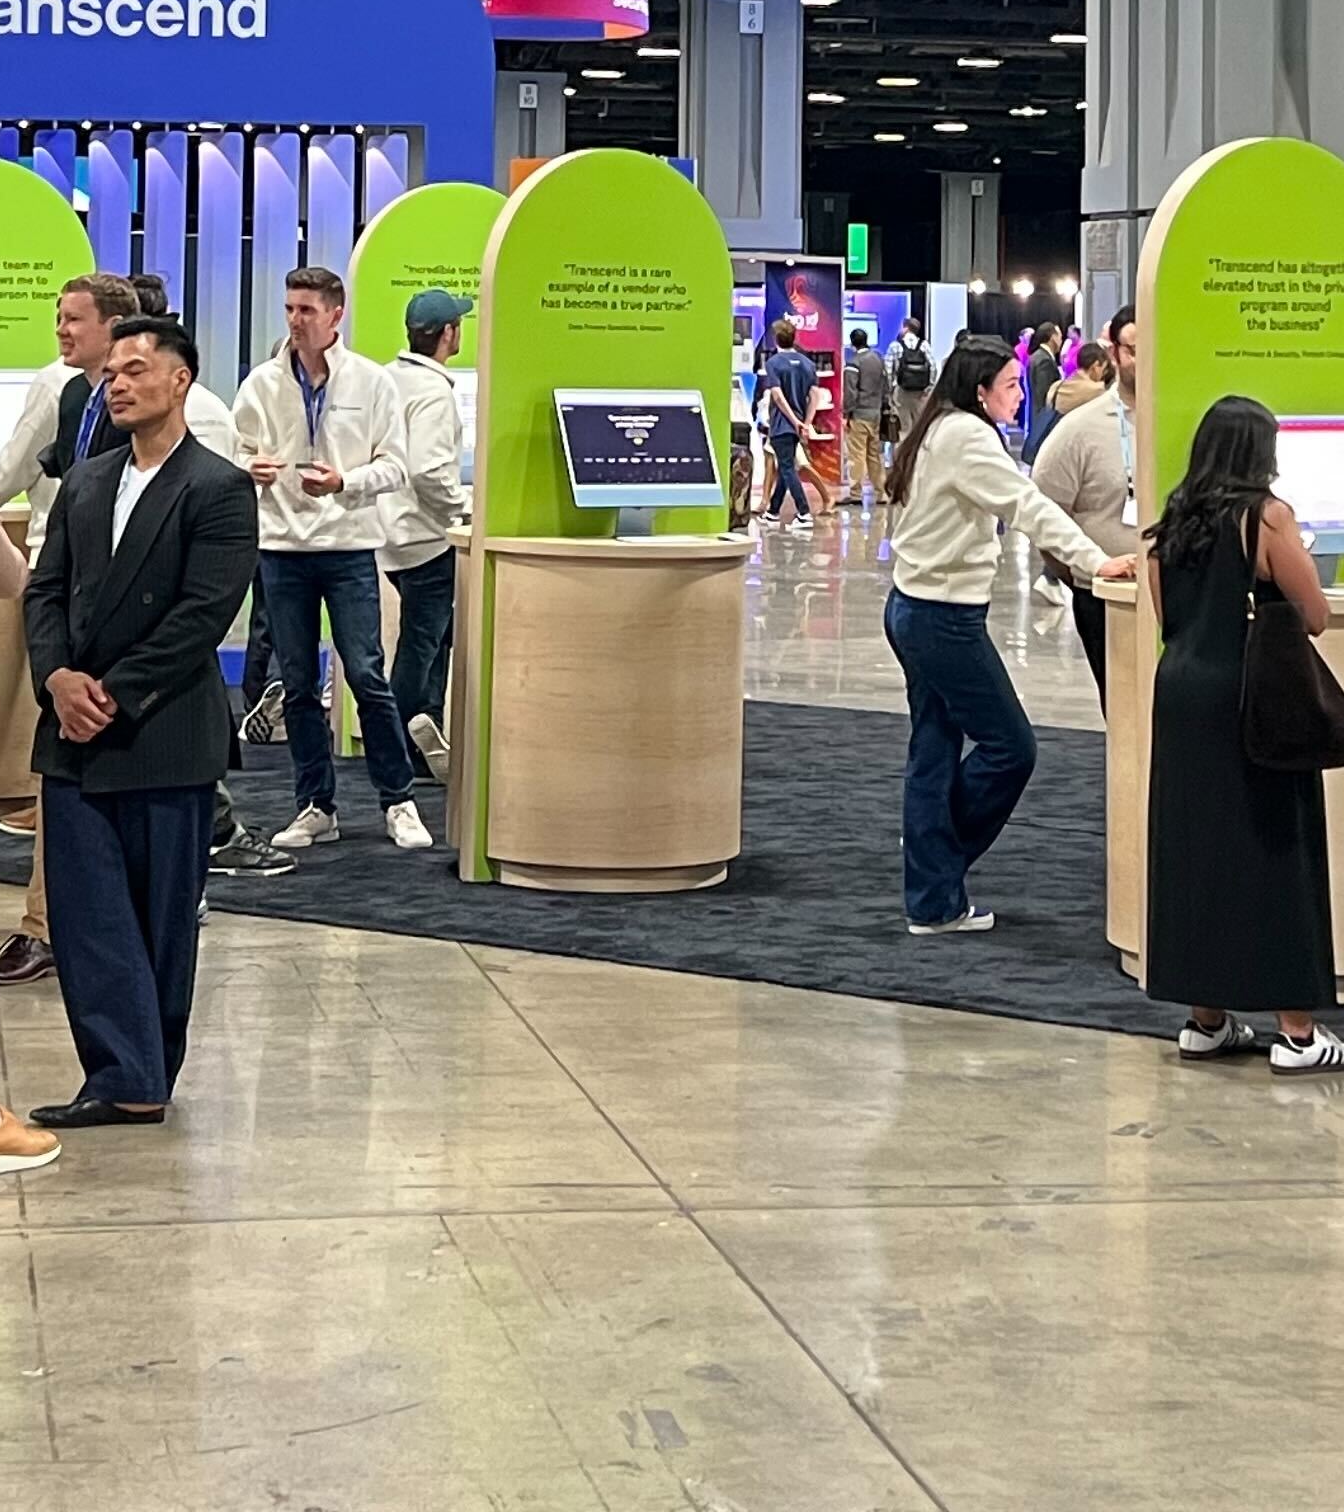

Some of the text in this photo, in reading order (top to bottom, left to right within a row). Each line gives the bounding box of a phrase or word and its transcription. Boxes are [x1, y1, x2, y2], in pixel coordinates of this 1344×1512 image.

[3, 260, 30, 269] team
[33, 260, 53, 270] and
[1277, 261, 1297, 273] has
[629, 267, 638, 277] is
[650, 269, 671, 278] rare
[17, 276, 33, 285] me
[36, 275, 48, 285] to
[1204, 278, 1254, 292] elevated
[1257, 281, 1285, 293] trust
[1289, 281, 1300, 292] in
[1303, 281, 1321, 293] the
[548, 282, 595, 294] example
[598, 282, 610, 293] of
[622, 283, 660, 294] vendor
[663, 283, 687, 295] who
[541, 297, 561, 308] has
[564, 298, 608, 309] become
[621, 300, 643, 309] true
[1240, 299, 1331, 314] program around
[1247, 318, 1266, 331] the
